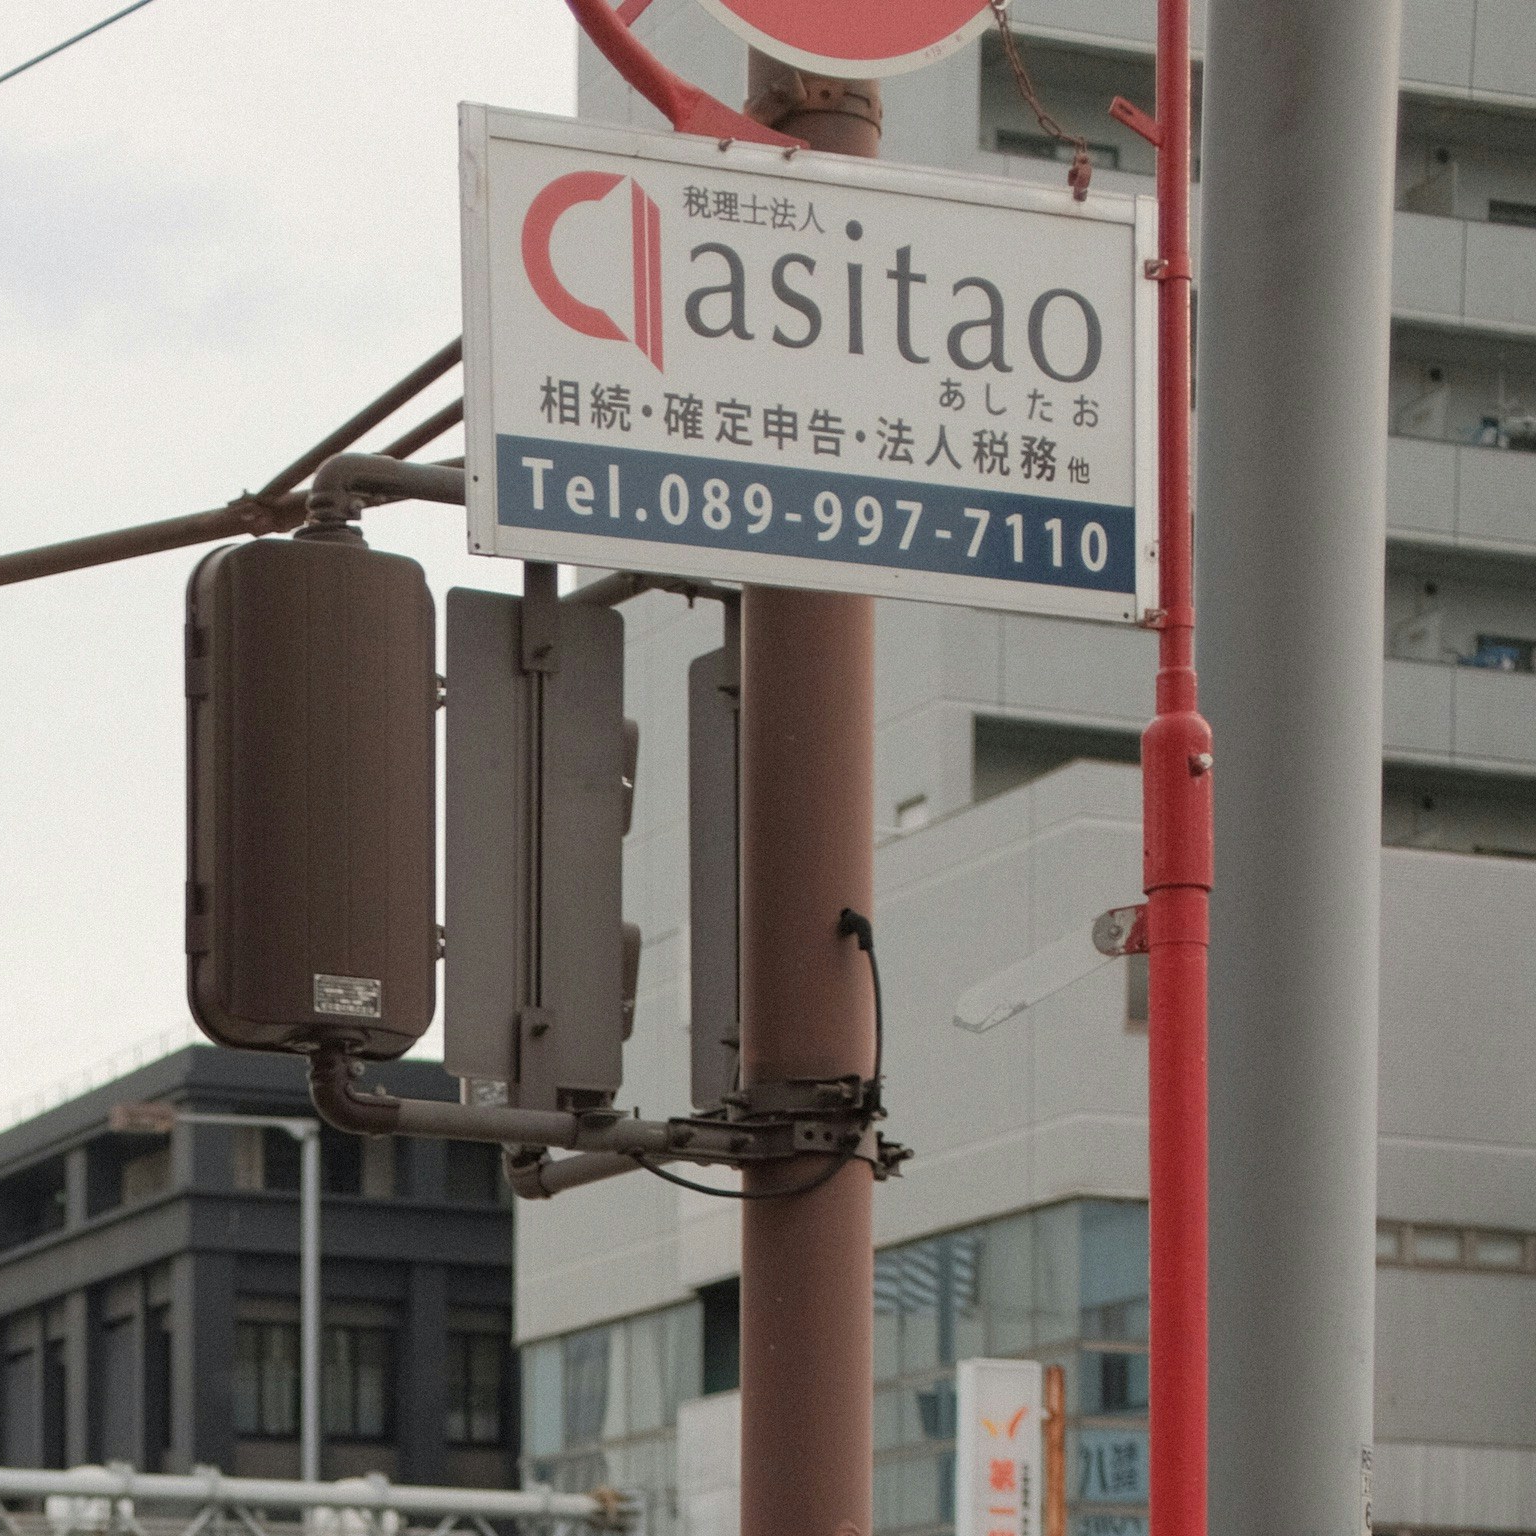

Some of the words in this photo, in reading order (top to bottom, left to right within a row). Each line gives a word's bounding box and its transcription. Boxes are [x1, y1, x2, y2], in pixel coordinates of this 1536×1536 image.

[683, 184, 825, 235] 税理士法人
[684, 219, 1103, 384] asitao
[939, 377, 1099, 428] あしたお
